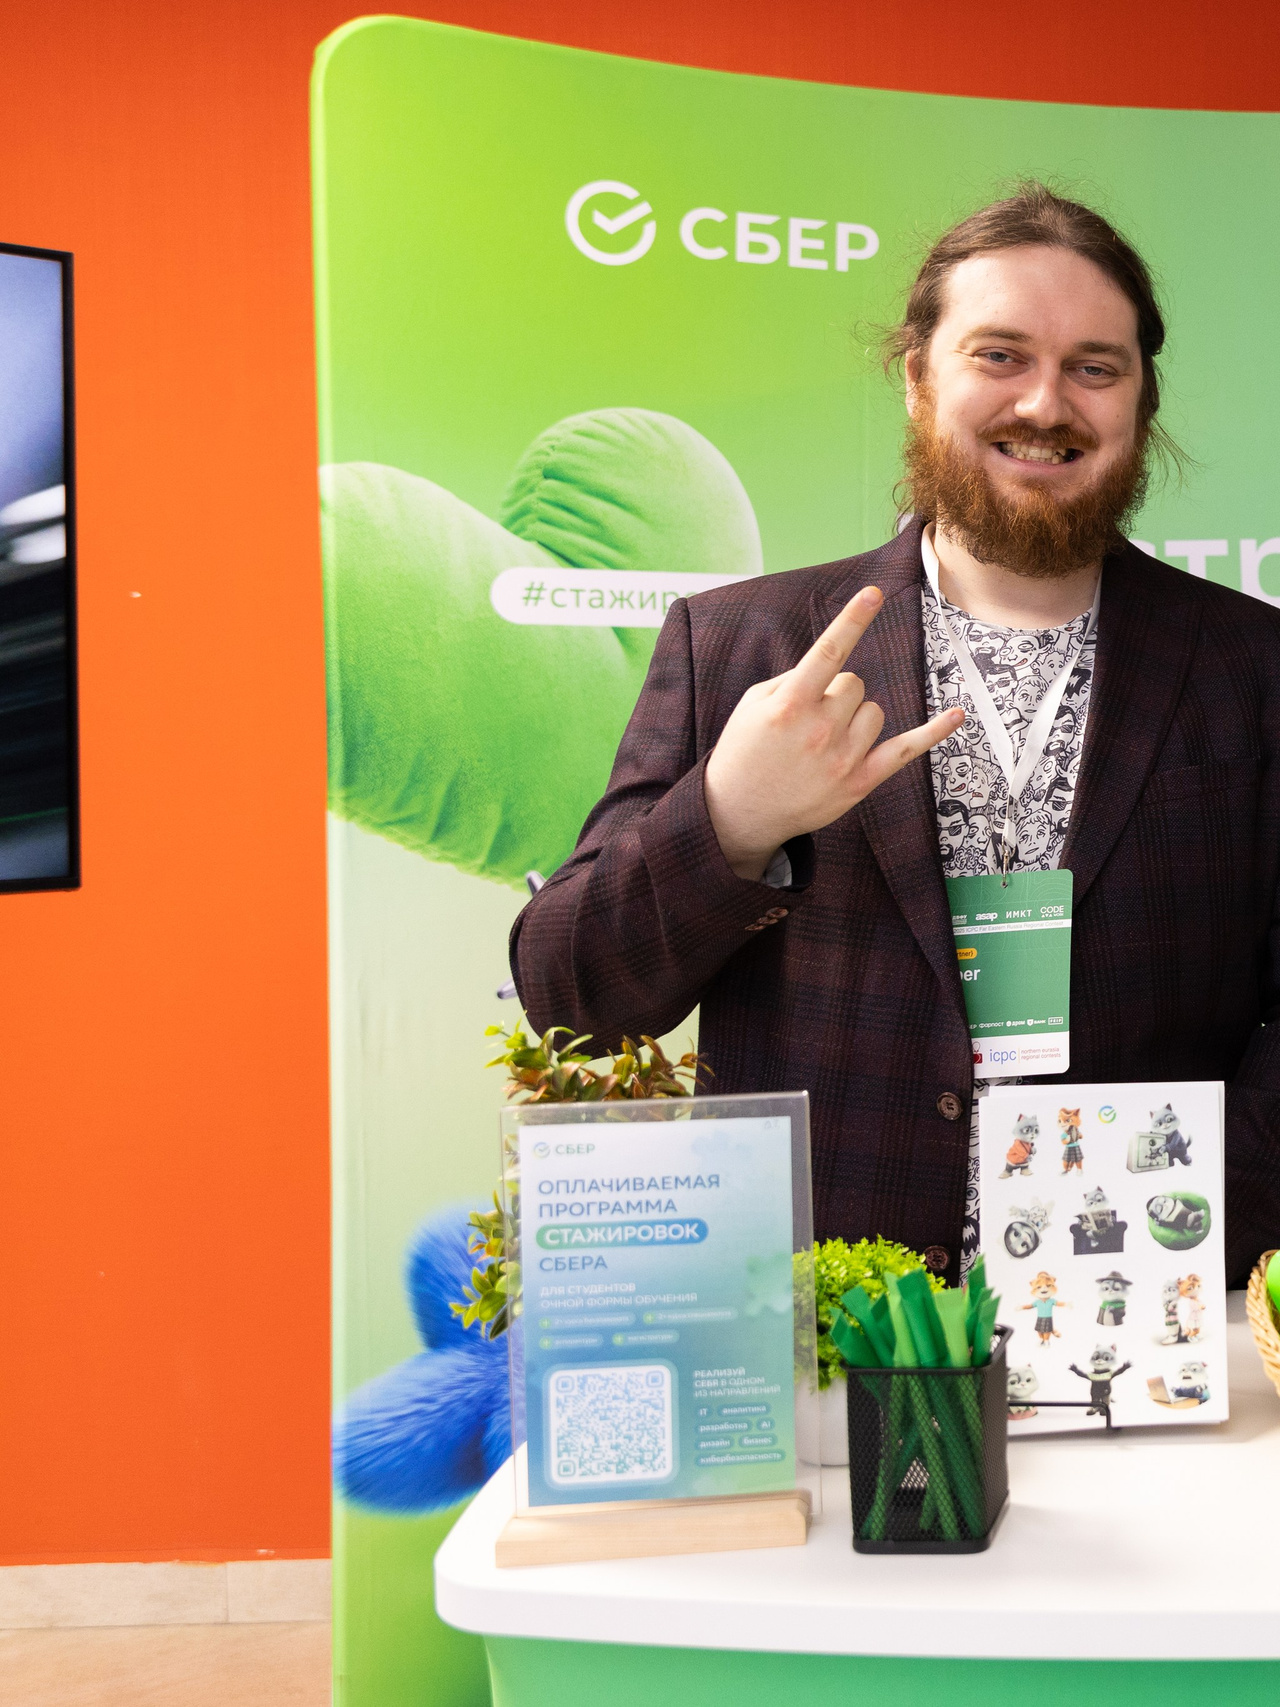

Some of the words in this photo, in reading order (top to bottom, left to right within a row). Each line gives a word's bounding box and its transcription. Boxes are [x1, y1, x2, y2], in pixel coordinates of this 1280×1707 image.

[679, 206, 880, 272] СБЕР
[975, 912, 998, 922] asap
[1005, 909, 1032, 919] ИМКТ
[1040, 905, 1065, 914] CODE
[960, 969, 981, 981] er
[989, 1049, 1017, 1065] icpc
[555, 1143, 596, 1155] СБЕР
[537, 1174, 720, 1195] ОПЛАЧИВАЕМАЯ
[538, 1199, 678, 1218] ПРОГРАММА
[544, 1222, 699, 1245] СТАЖИРОВОК
[539, 1255, 608, 1272] СБЕРА
[540, 1286, 565, 1297] ДЛЯ
[568, 1283, 636, 1295] СТУДЕНТОВ
[541, 1297, 584, 1309] ОЧНОЙ
[587, 1296, 632, 1307] ФОРМЫ
[635, 1293, 698, 1305] ОБУЧЕНИЯ
[694, 1366, 746, 1378] РЕАЛИЗУЙ
[694, 1378, 719, 1388] СЕБЯ
[729, 1376, 765, 1387] ОДНОМ
[695, 1389, 708, 1398] ИЗ
[710, 1384, 781, 1397] НАПРАВЛЕНИЙ
[699, 1422, 748, 1433] разработка
